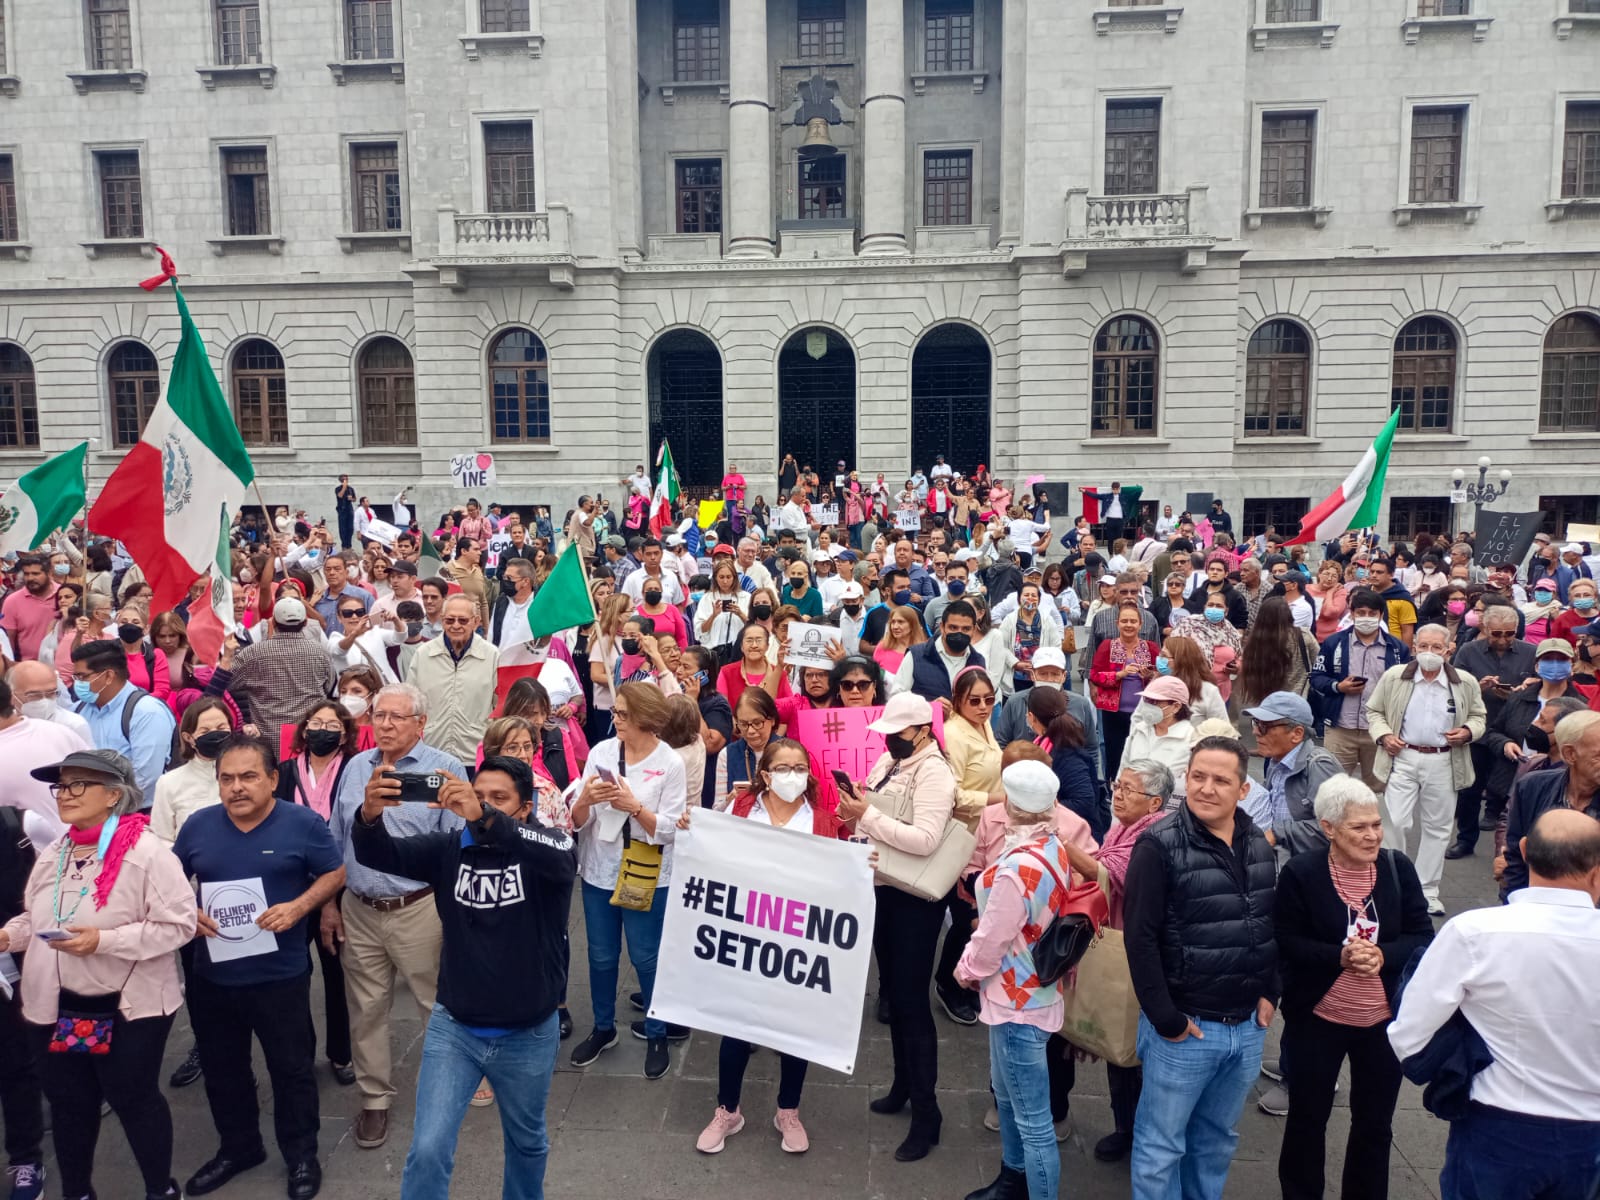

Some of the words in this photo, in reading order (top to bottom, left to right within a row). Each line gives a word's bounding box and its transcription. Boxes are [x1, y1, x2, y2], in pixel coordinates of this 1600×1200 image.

[463, 470, 487, 487] INE
[902, 517, 918, 526] INE
[1499, 515, 1521, 527] EL
[213, 902, 257, 919] #ELINENO
[682, 876, 859, 951] #ELINENO
[219, 914, 253, 929] SETOCA
[694, 924, 832, 994] SETOCA
